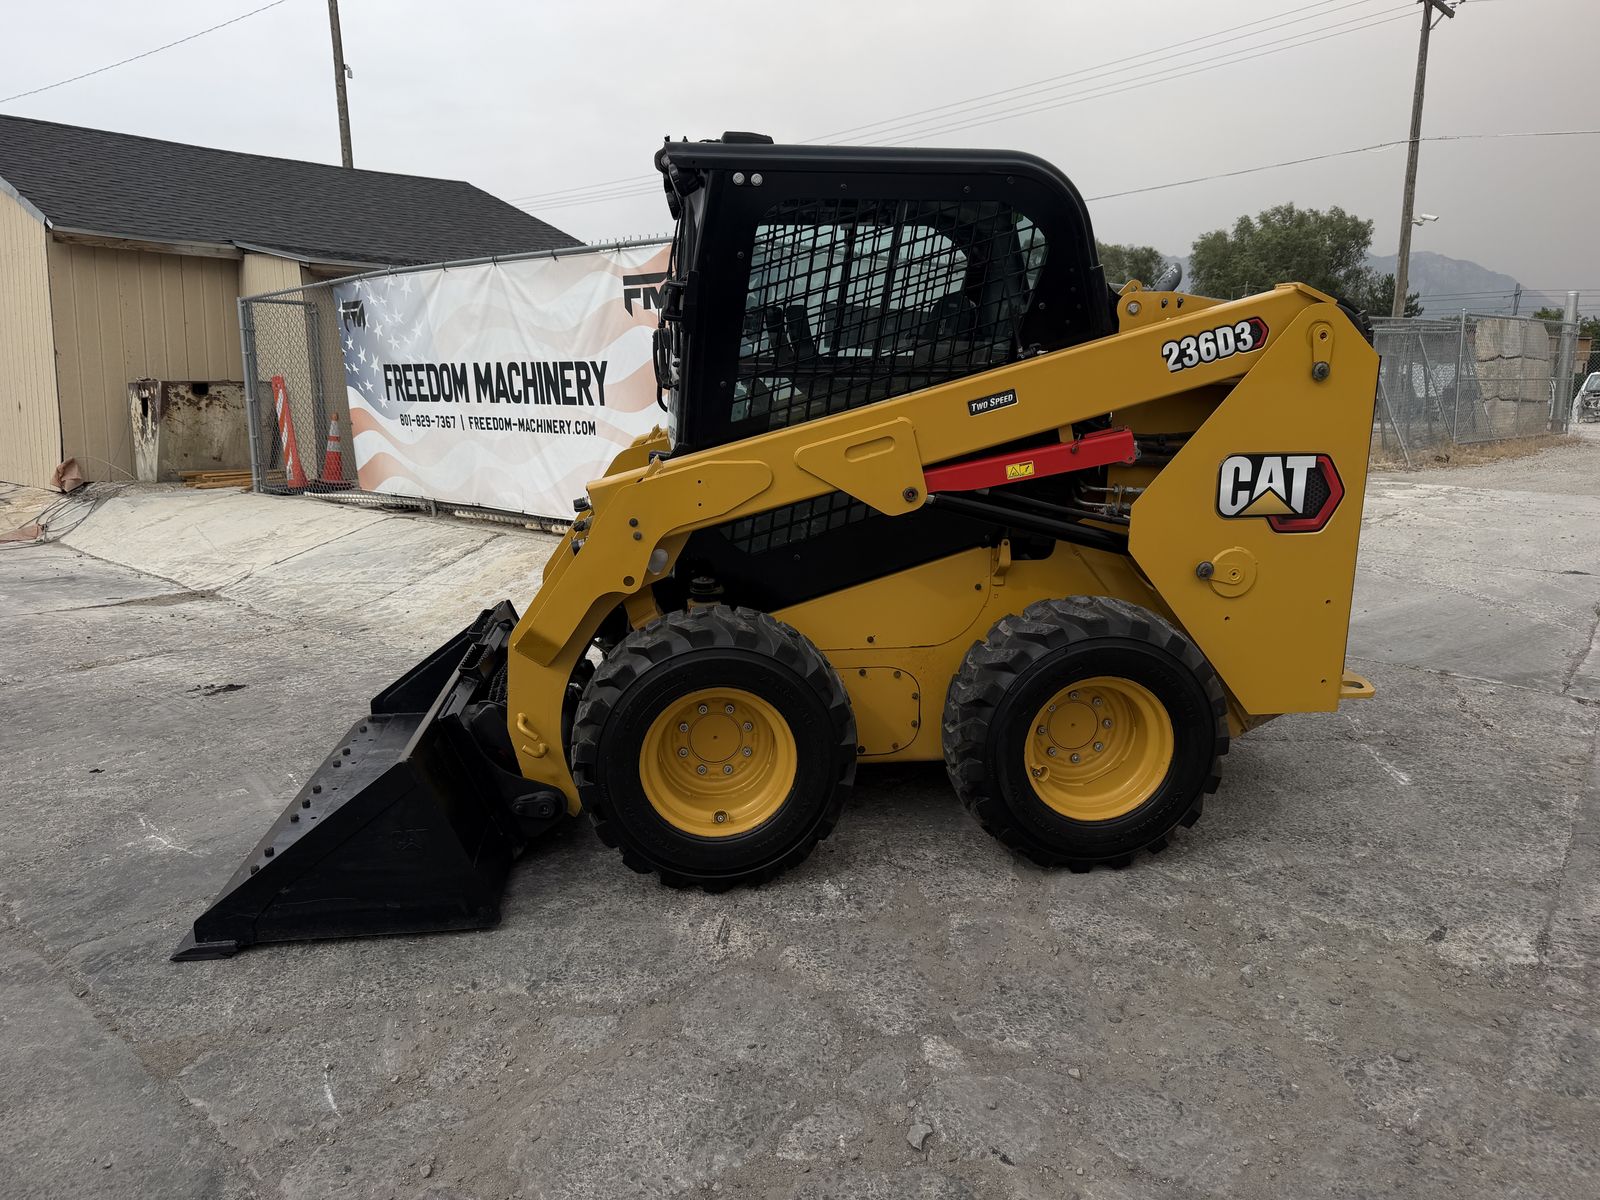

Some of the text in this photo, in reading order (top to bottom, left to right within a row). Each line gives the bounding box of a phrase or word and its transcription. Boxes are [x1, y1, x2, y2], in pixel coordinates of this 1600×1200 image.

[1162, 321, 1254, 371] 236D3
[383, 360, 608, 406] FREEDOM MACHINERY
[400, 413, 456, 429] 801-829-7367
[468, 416, 596, 436] FREEDOM-MACHINERY.COM
[1219, 456, 1316, 515] CAT
